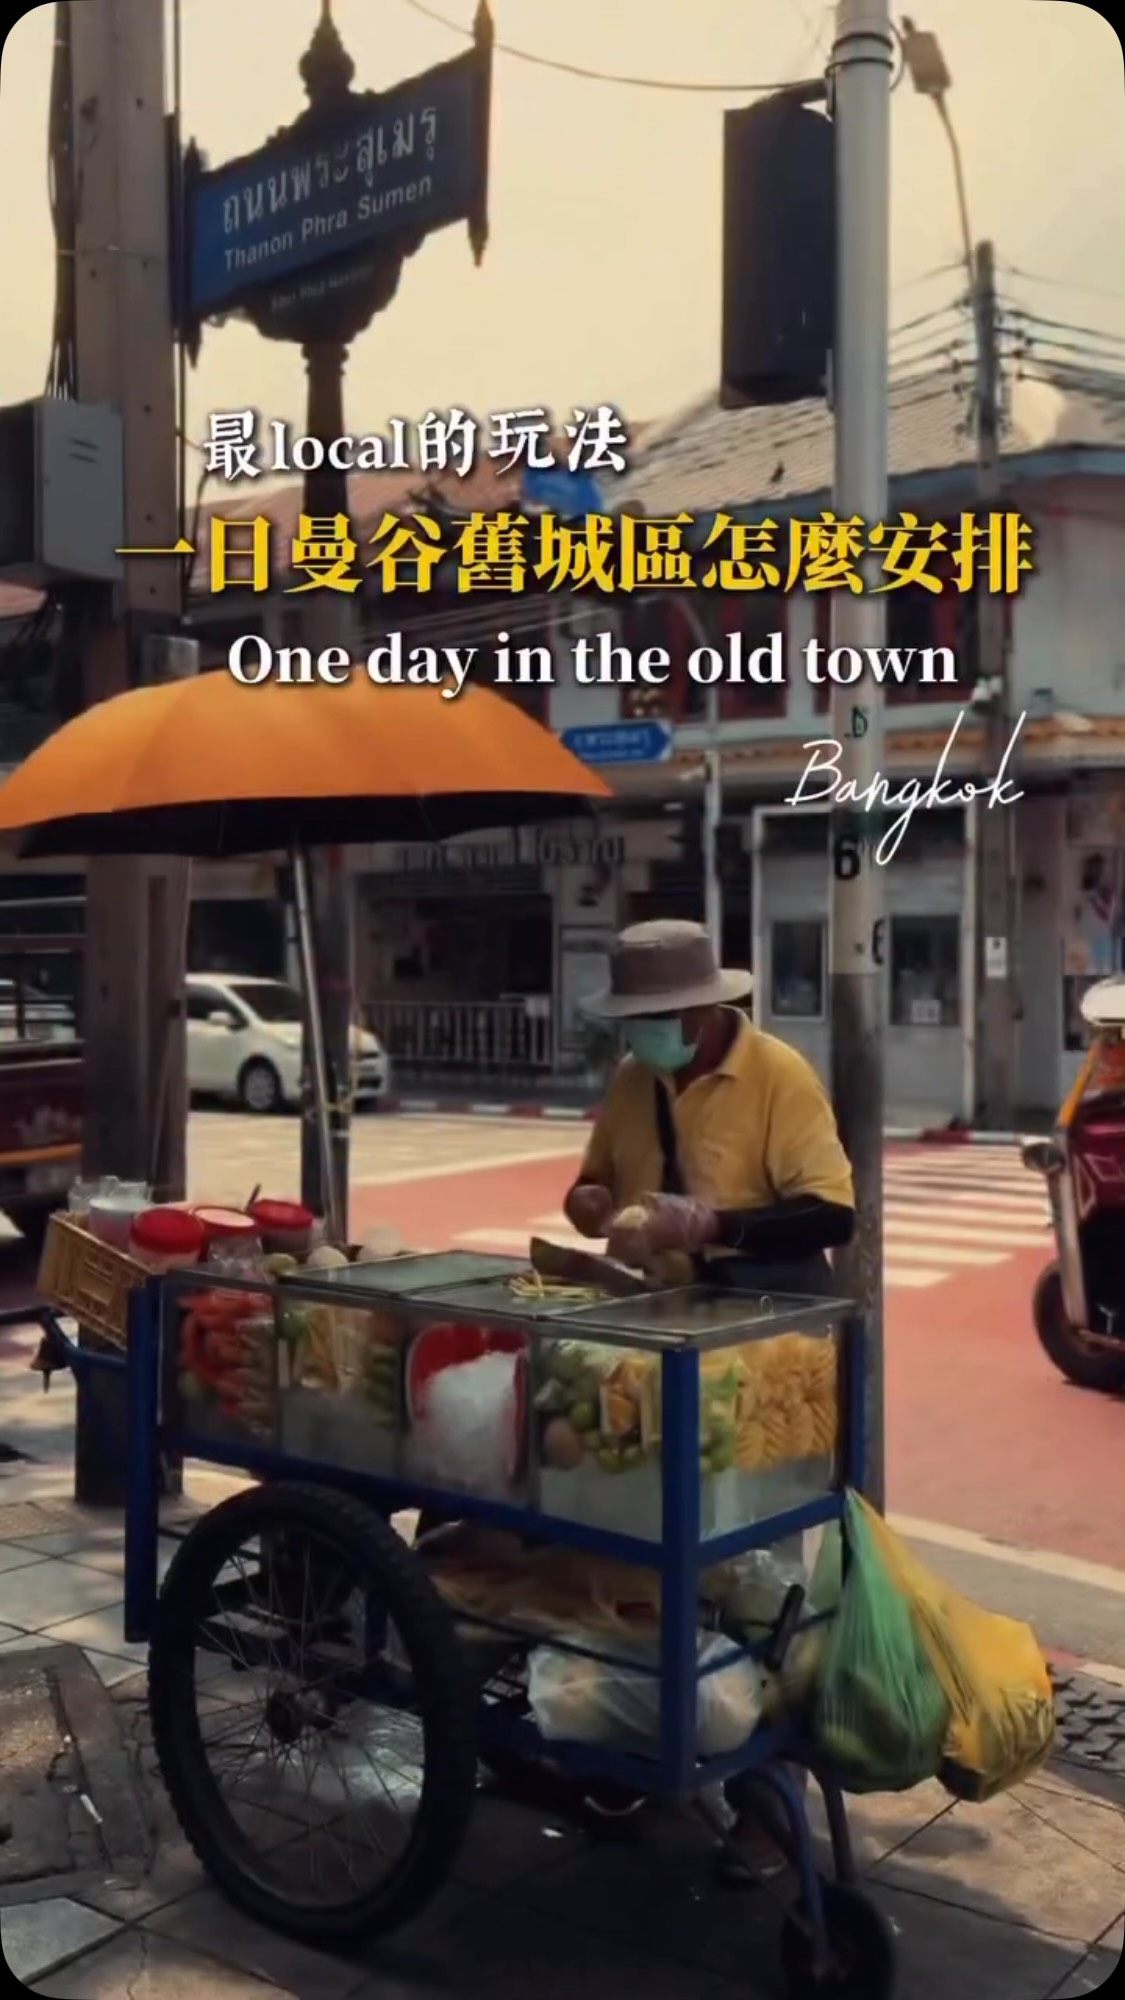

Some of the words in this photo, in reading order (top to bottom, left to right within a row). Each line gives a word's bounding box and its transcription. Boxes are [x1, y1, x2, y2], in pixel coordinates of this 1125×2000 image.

[222, 106, 438, 235] ถนนพระสุเมรุ
[224, 230, 293, 273] Thanon
[301, 208, 348, 242] Phra
[357, 174, 433, 220] Sumen
